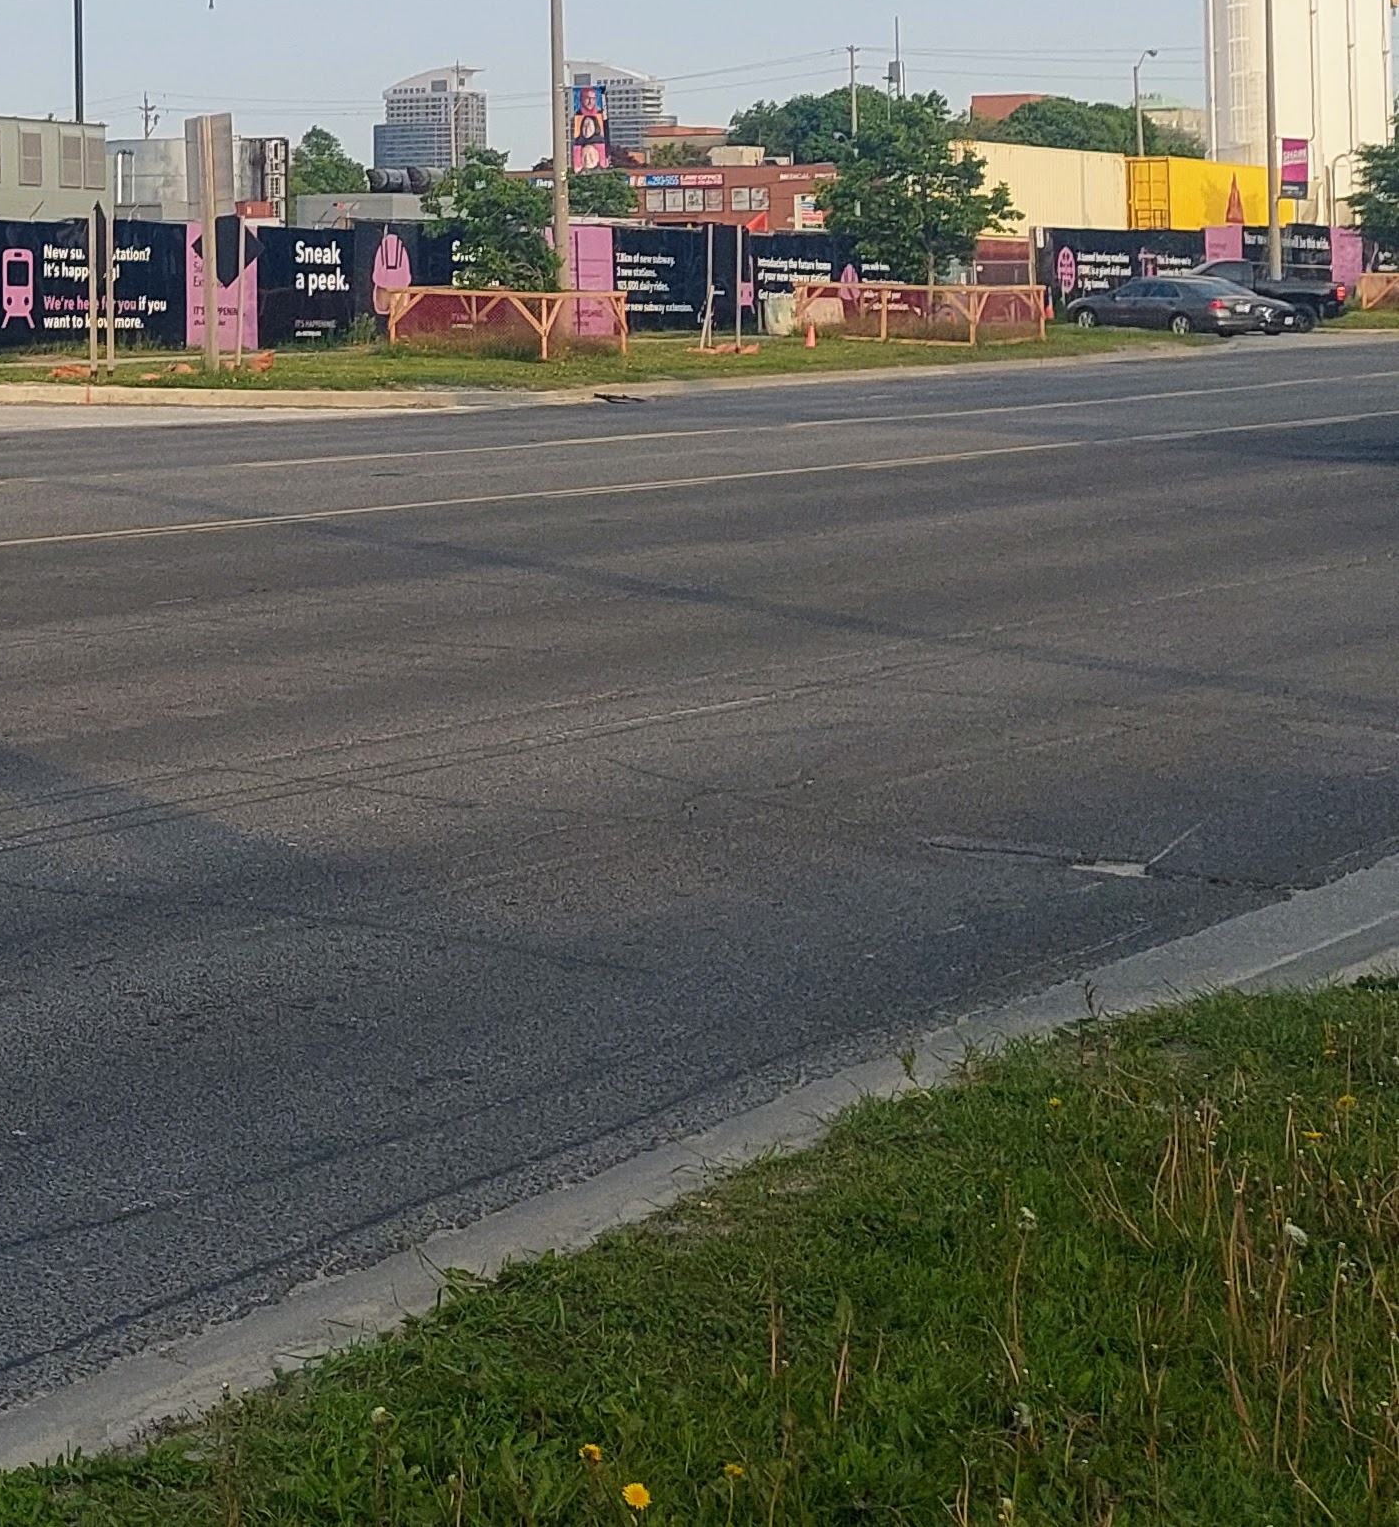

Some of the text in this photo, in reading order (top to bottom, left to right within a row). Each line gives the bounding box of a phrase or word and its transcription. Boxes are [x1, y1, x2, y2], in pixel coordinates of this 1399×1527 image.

[44, 244, 69, 259] New
[295, 240, 342, 265] Sneak
[44, 260, 120, 282] It's happg!
[621, 269, 633, 277] new
[295, 275, 305, 290] a
[44, 295, 74, 310] We're
[76, 295, 100, 311] hee
[117, 300, 137, 315] you
[138, 295, 147, 311] if
[147, 300, 167, 315] you
[44, 316, 71, 330] want
[72, 316, 83, 330] to
[114, 318, 145, 330] more.
